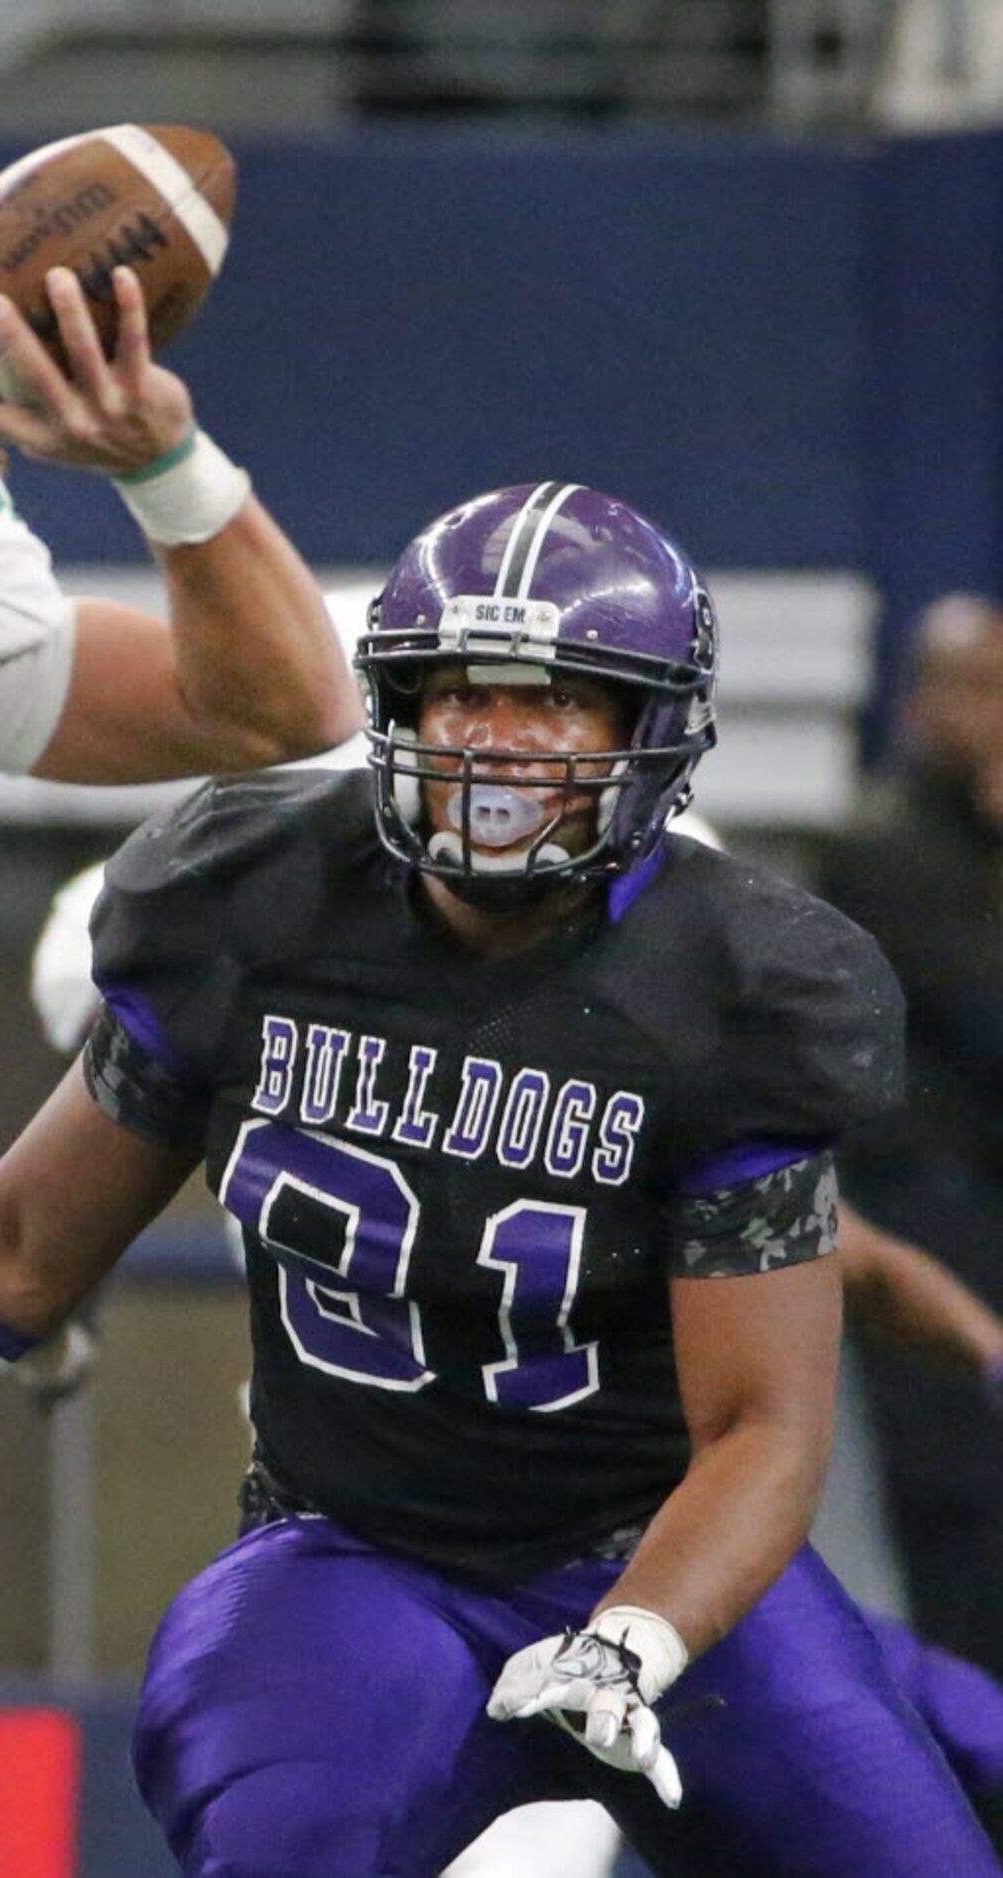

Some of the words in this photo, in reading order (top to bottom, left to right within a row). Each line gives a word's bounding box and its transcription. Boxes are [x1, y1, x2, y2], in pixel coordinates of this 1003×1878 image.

[475, 604, 500, 621] SIC
[504, 605, 527, 624] EM
[250, 1014, 645, 1186] BULLDOGS
[217, 1117, 601, 1414] 81
